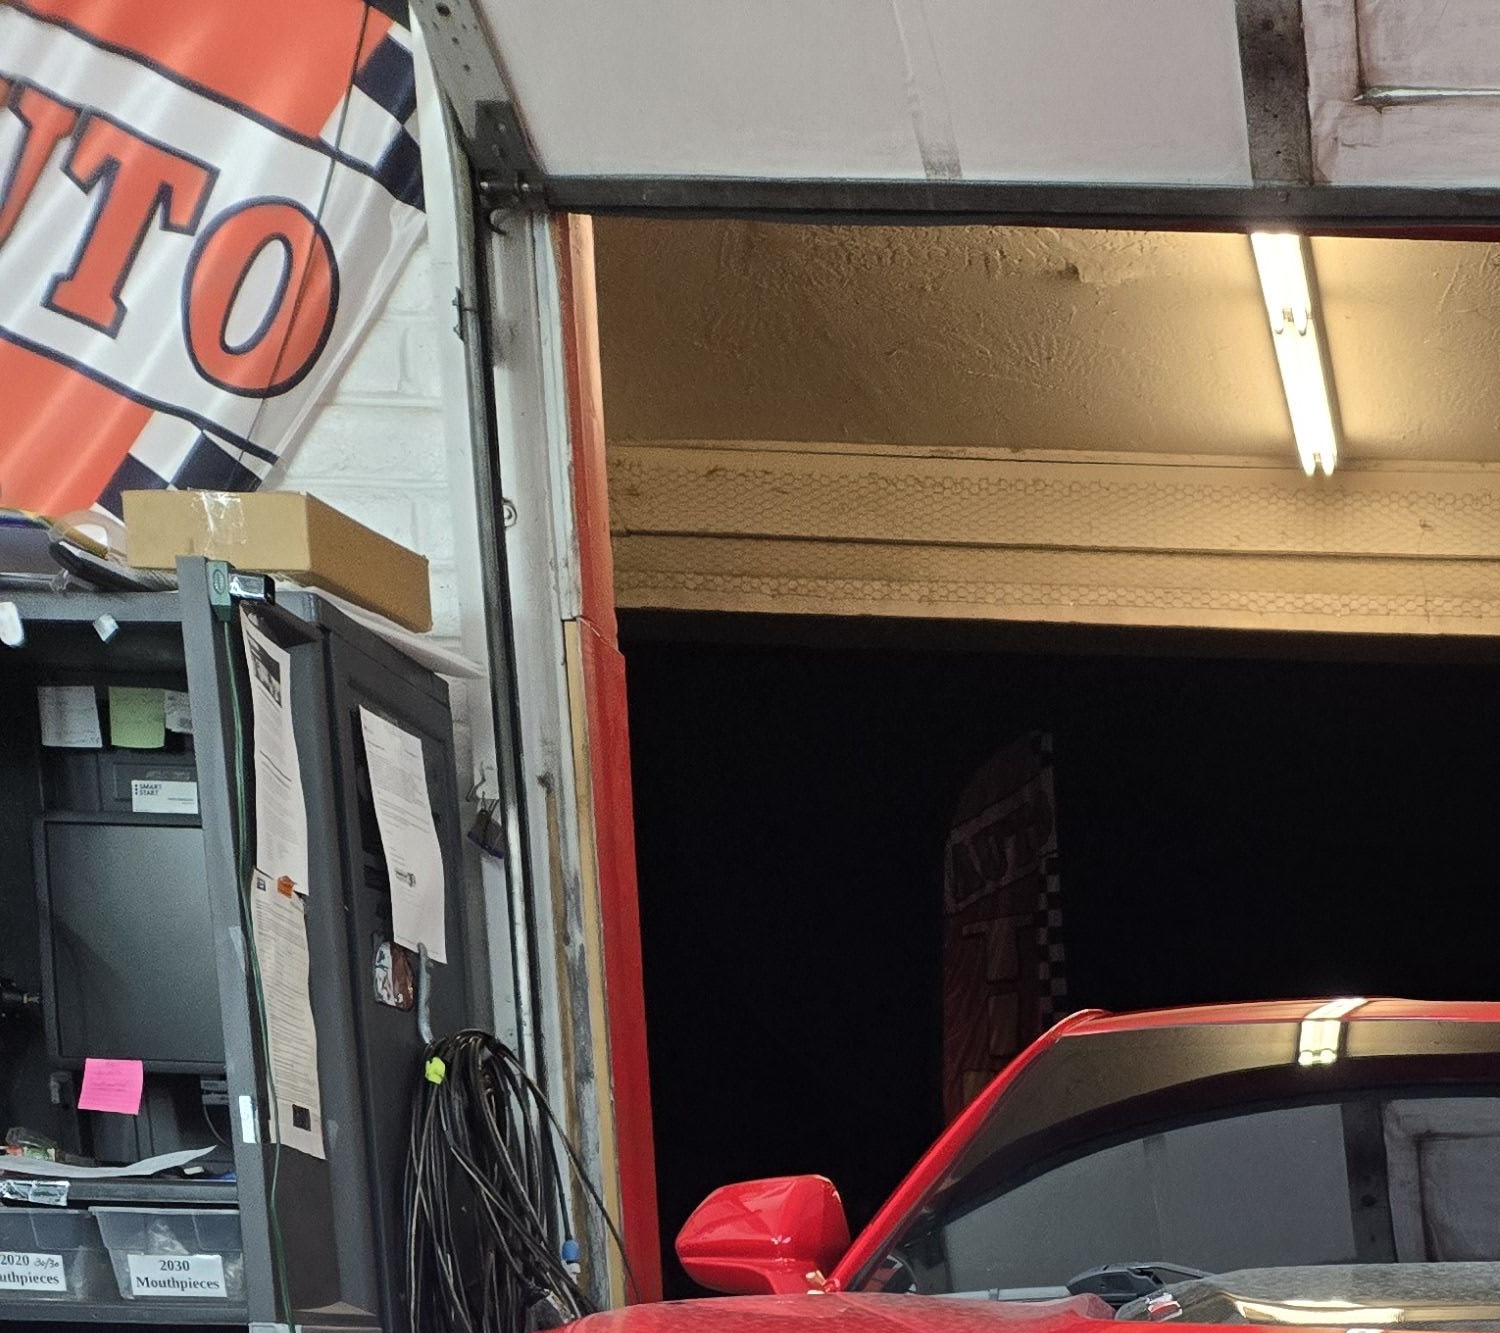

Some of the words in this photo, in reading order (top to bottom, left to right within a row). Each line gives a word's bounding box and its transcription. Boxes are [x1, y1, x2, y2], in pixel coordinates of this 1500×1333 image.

[0, 1254, 30, 1266] 2020
[159, 1259, 191, 1272] 2030
[136, 1276, 220, 1292] Mouthpieces
